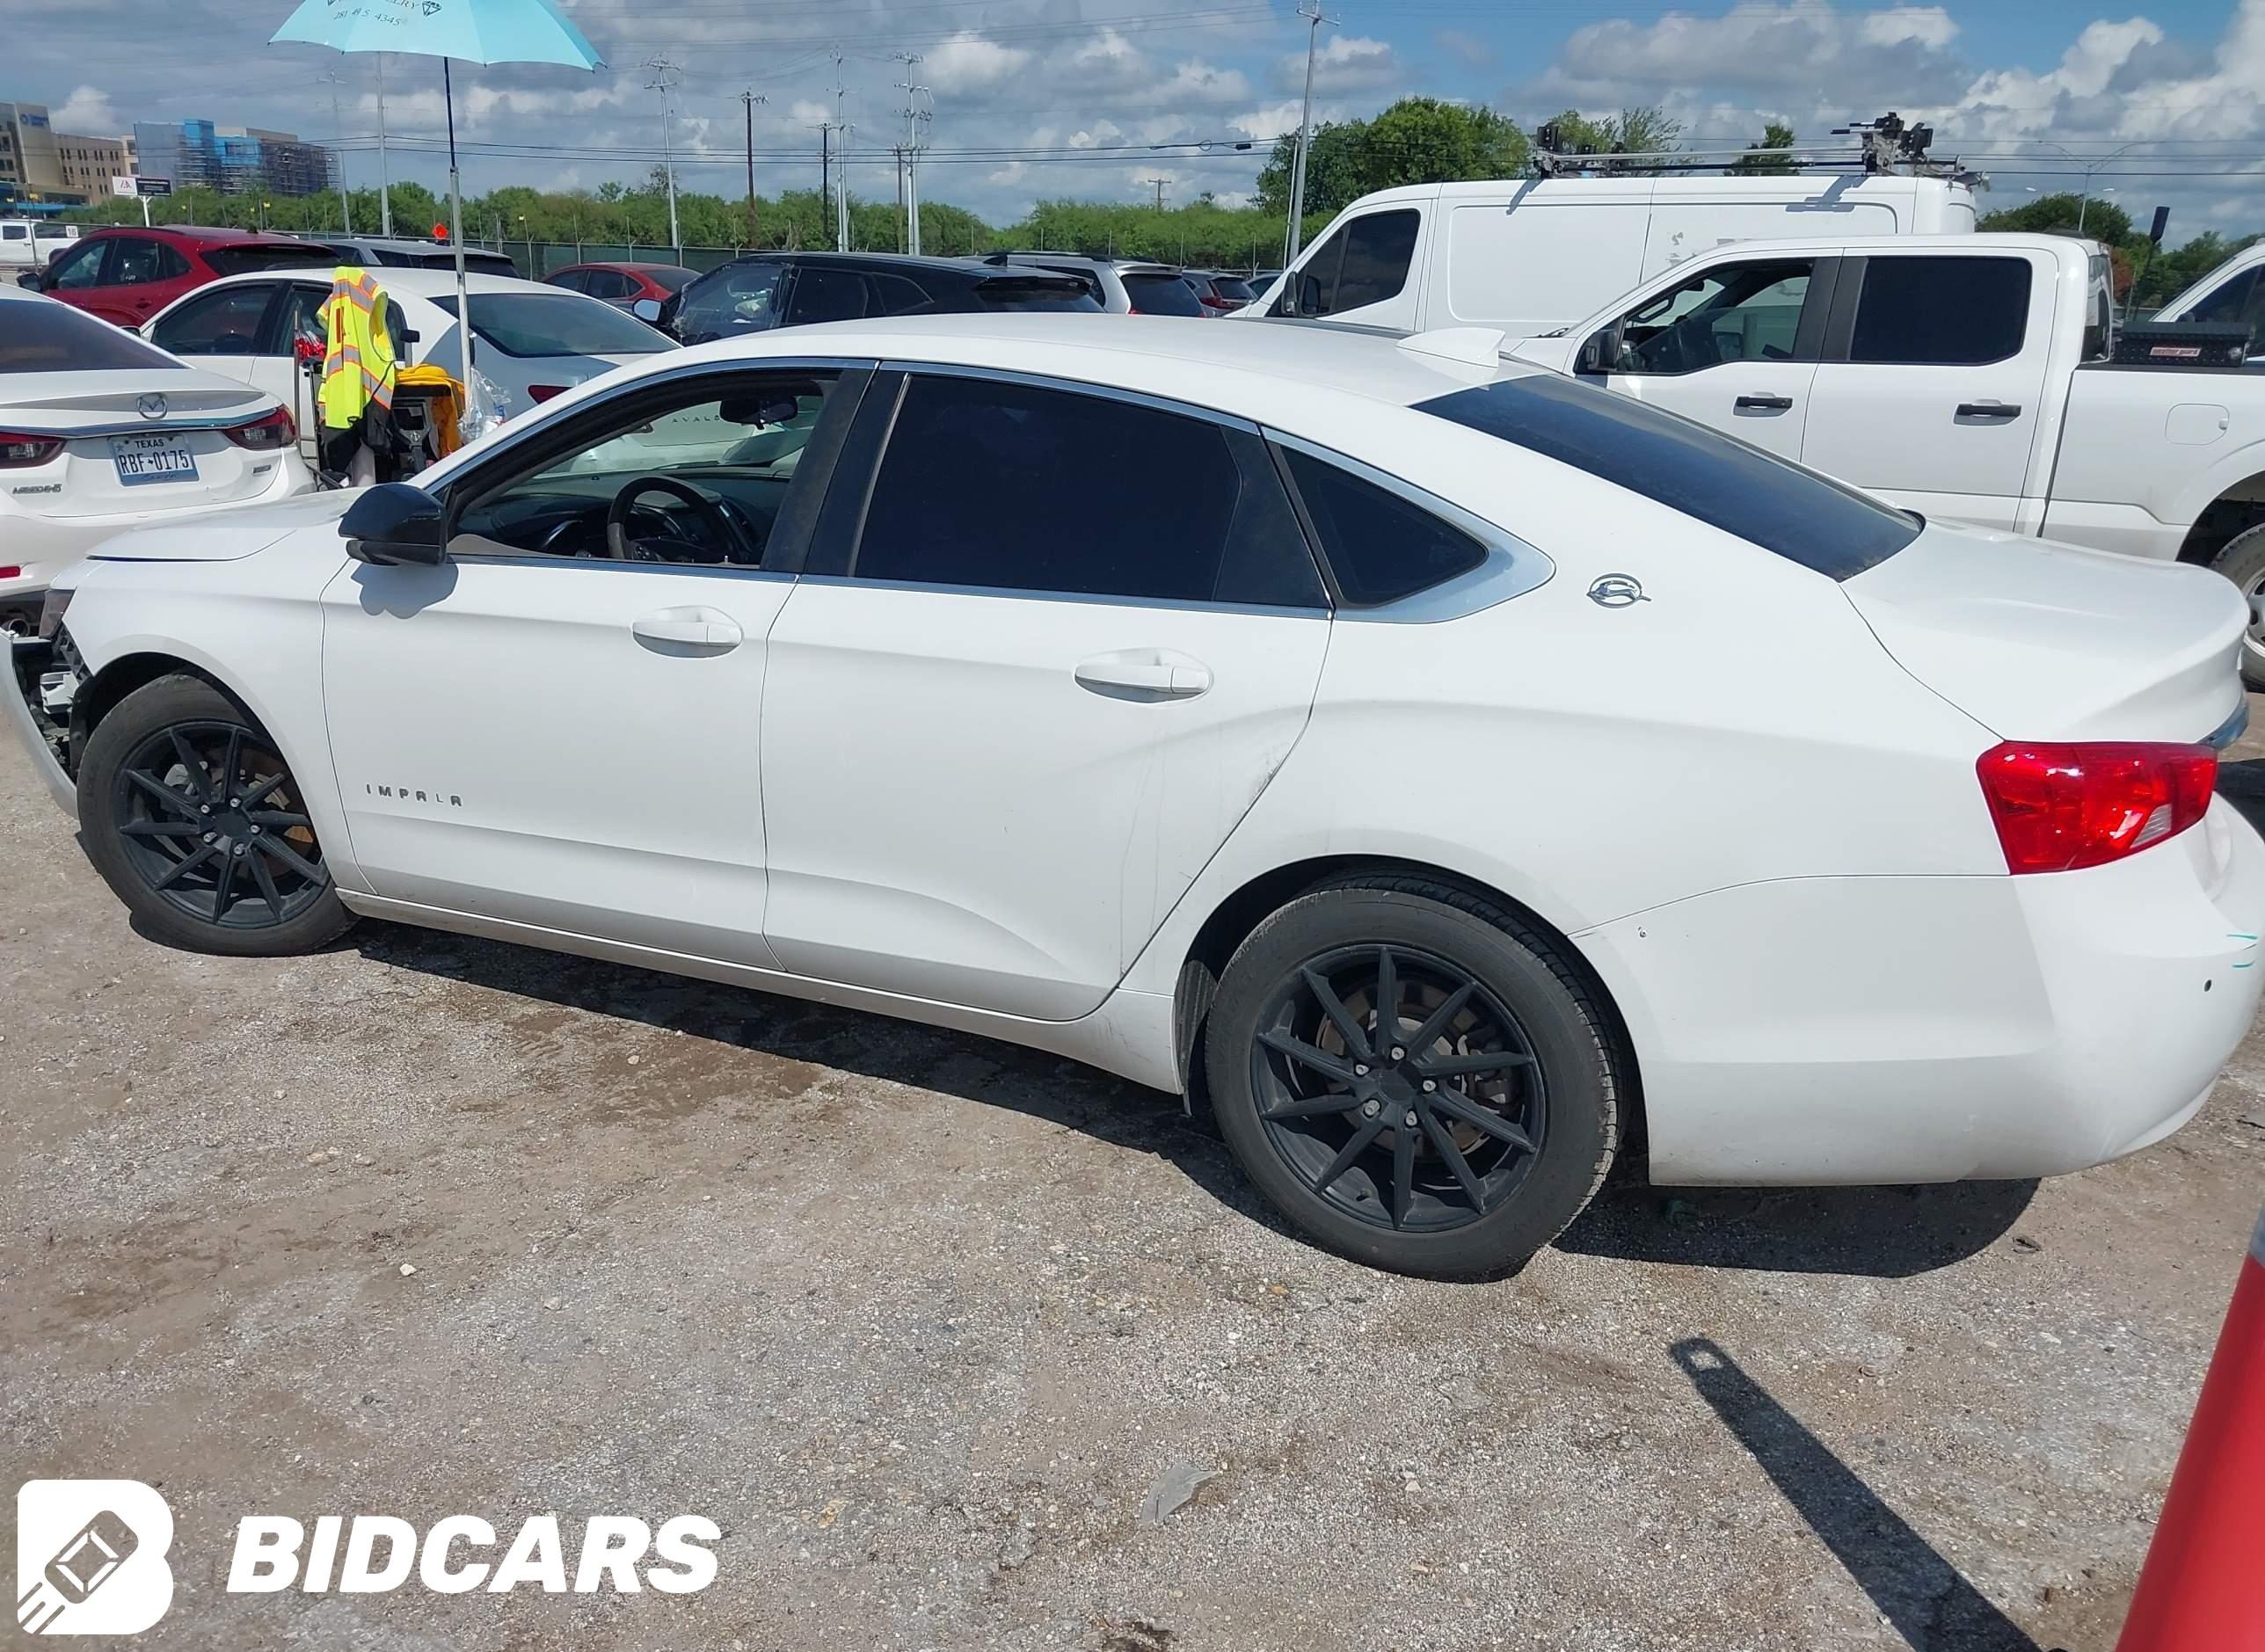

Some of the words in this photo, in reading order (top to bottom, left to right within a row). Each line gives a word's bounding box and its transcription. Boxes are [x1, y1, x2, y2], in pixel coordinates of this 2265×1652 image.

[671, 414, 721, 423] AVALO
[135, 439, 164, 448] TEXAS
[366, 783, 462, 807] IMPALA
